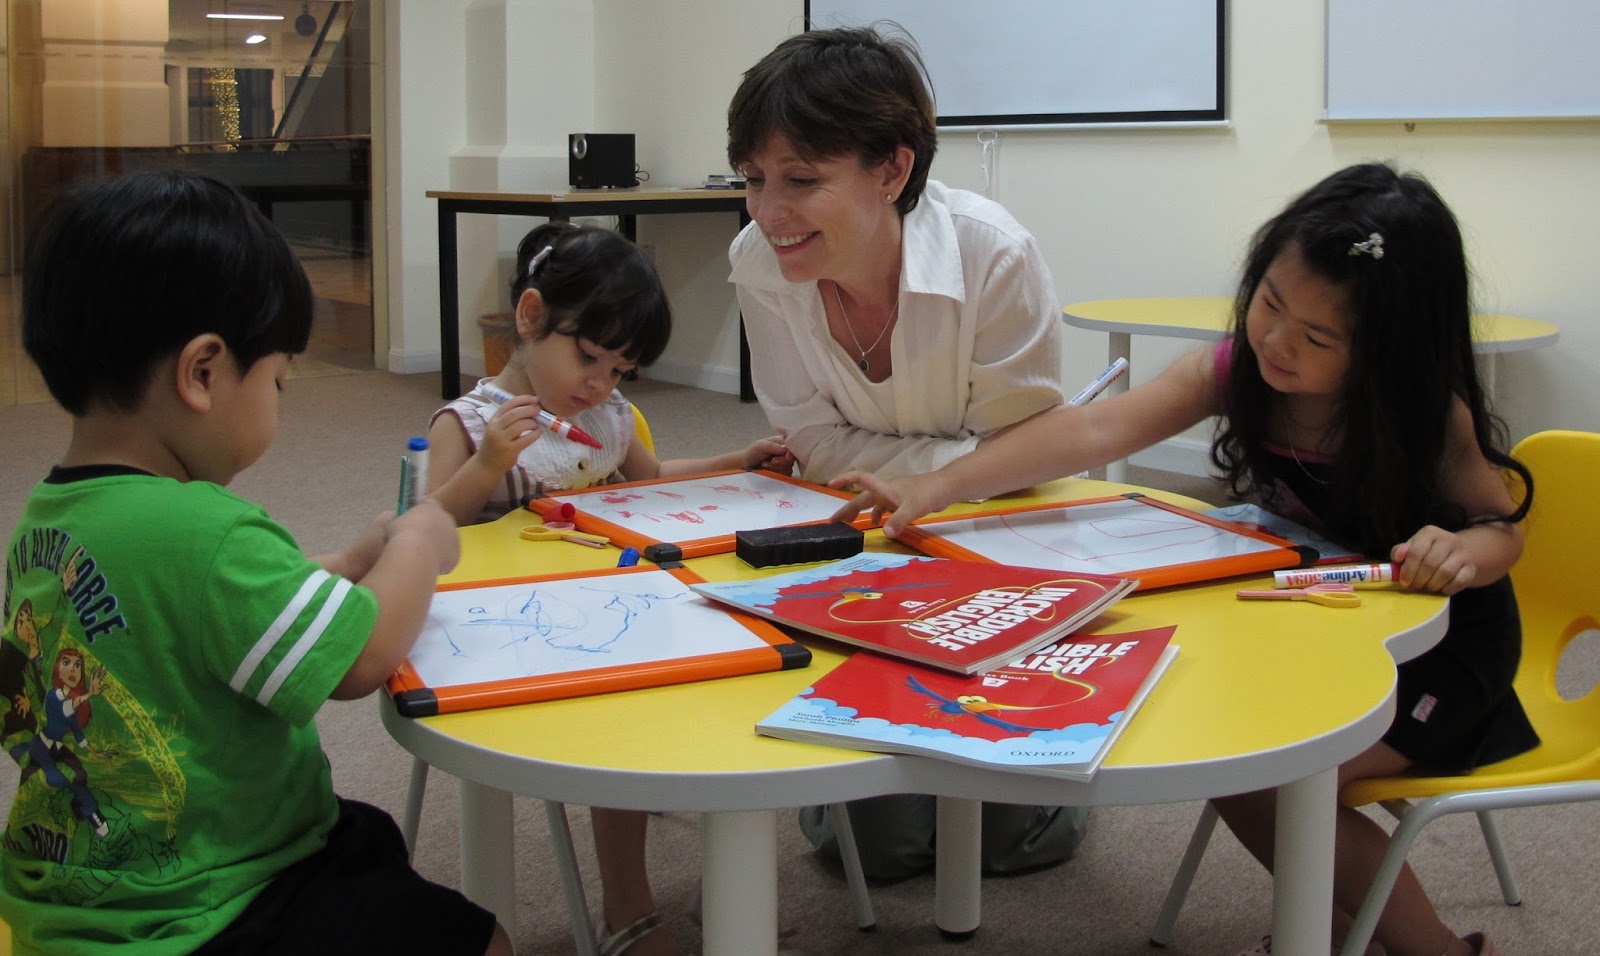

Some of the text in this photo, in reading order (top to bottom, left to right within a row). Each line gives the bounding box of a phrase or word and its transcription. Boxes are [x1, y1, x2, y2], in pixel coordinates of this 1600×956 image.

[900, 589, 1025, 635] ENGLISH
[927, 587, 1078, 651] INCREDIBLE
[1034, 640, 1139, 657] DIBLE
[1008, 654, 1098, 675] LISH
[1000, 673, 1030, 682] Book
